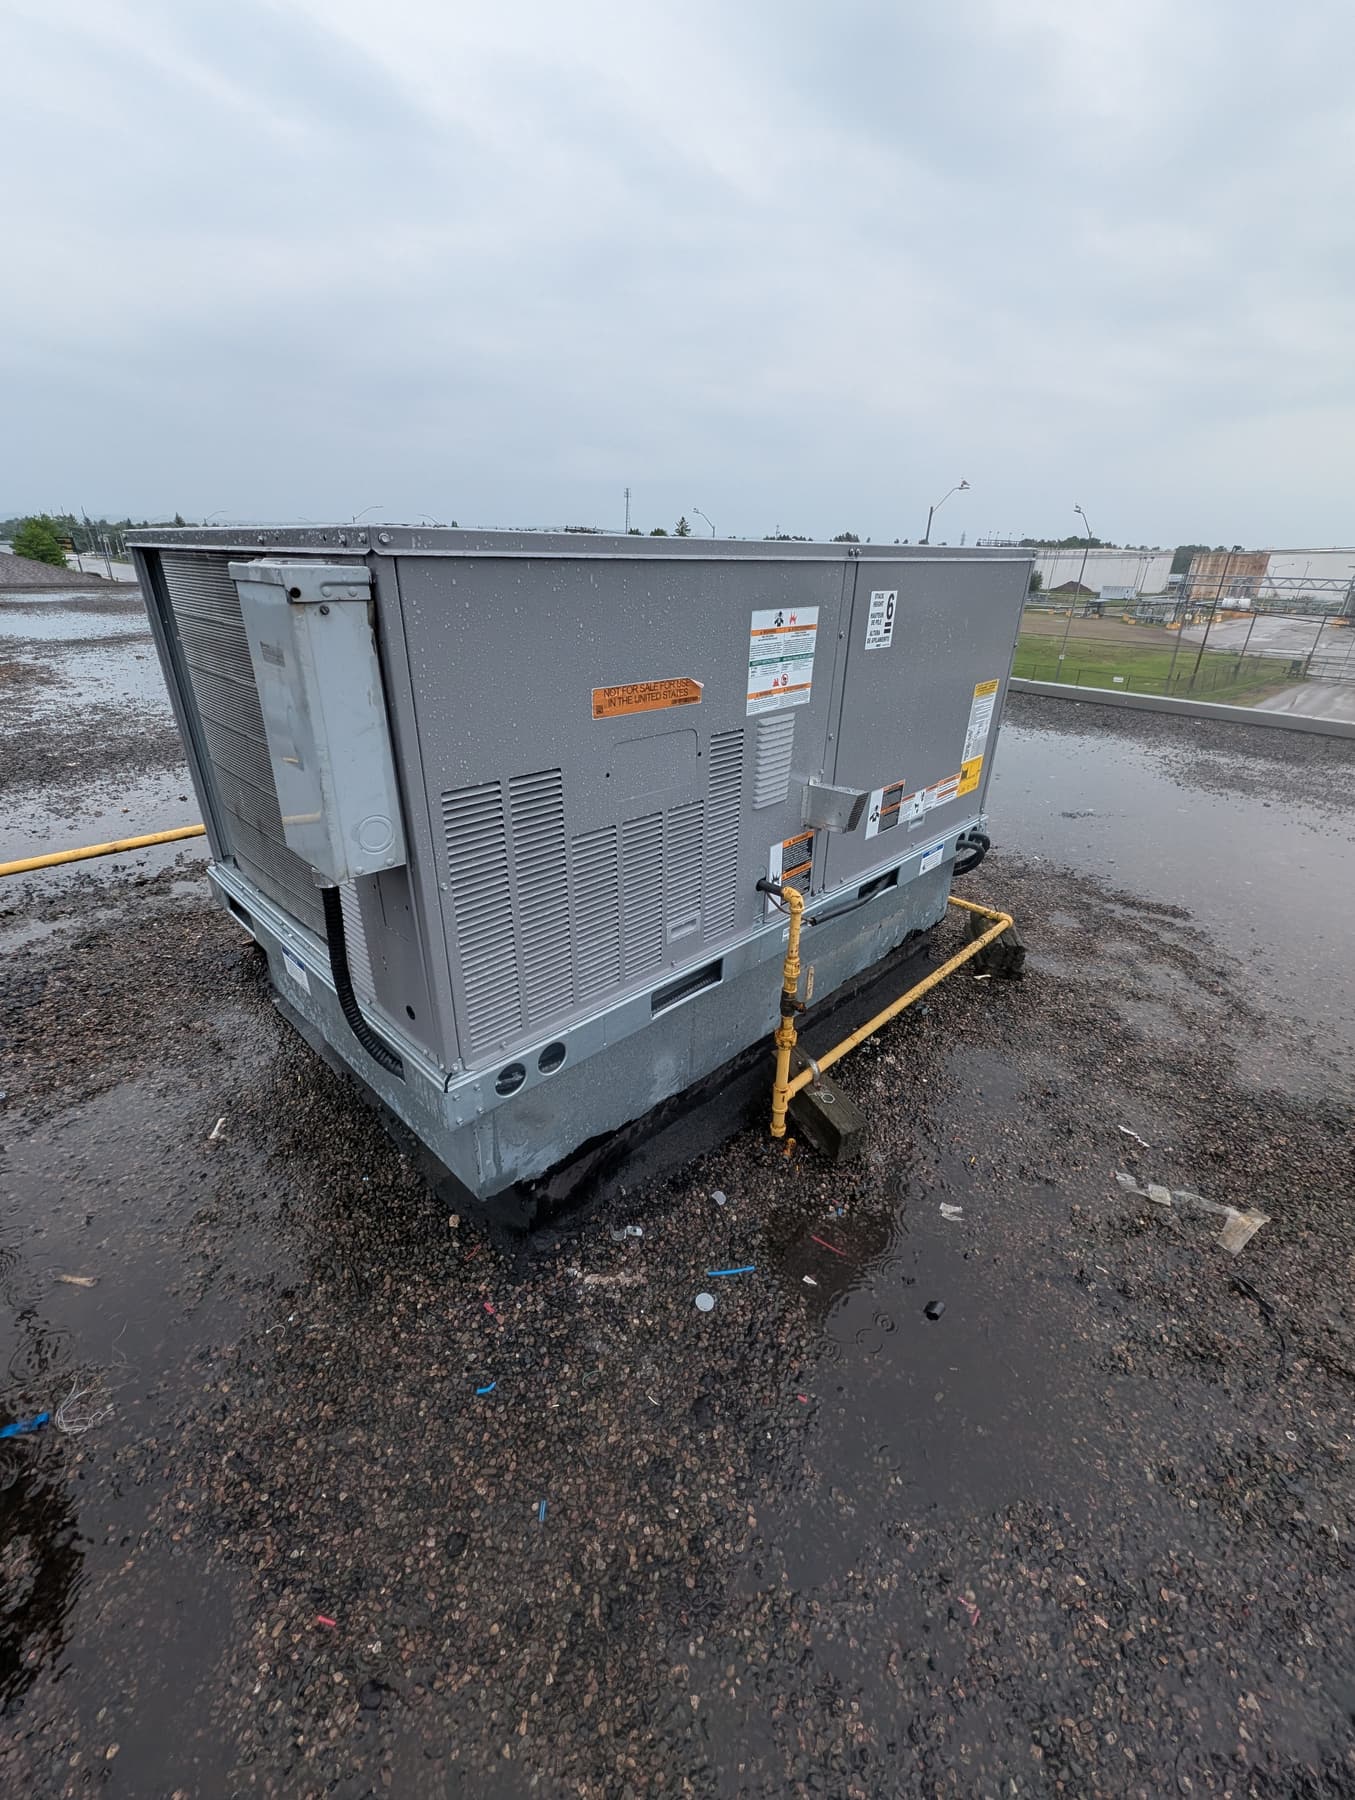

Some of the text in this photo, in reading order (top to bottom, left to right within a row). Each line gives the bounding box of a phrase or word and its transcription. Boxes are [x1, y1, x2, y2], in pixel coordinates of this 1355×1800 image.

[886, 593, 895, 620] 6
[604, 687, 620, 697] NOT
[621, 685, 638, 695] FOR
[640, 683, 658, 693] SALE
[659, 681, 675, 690] FOR
[608, 698, 616, 707] IN
[618, 696, 632, 705] THE
[634, 693, 662, 704] UNITED
[663, 688, 688, 699] STATES
